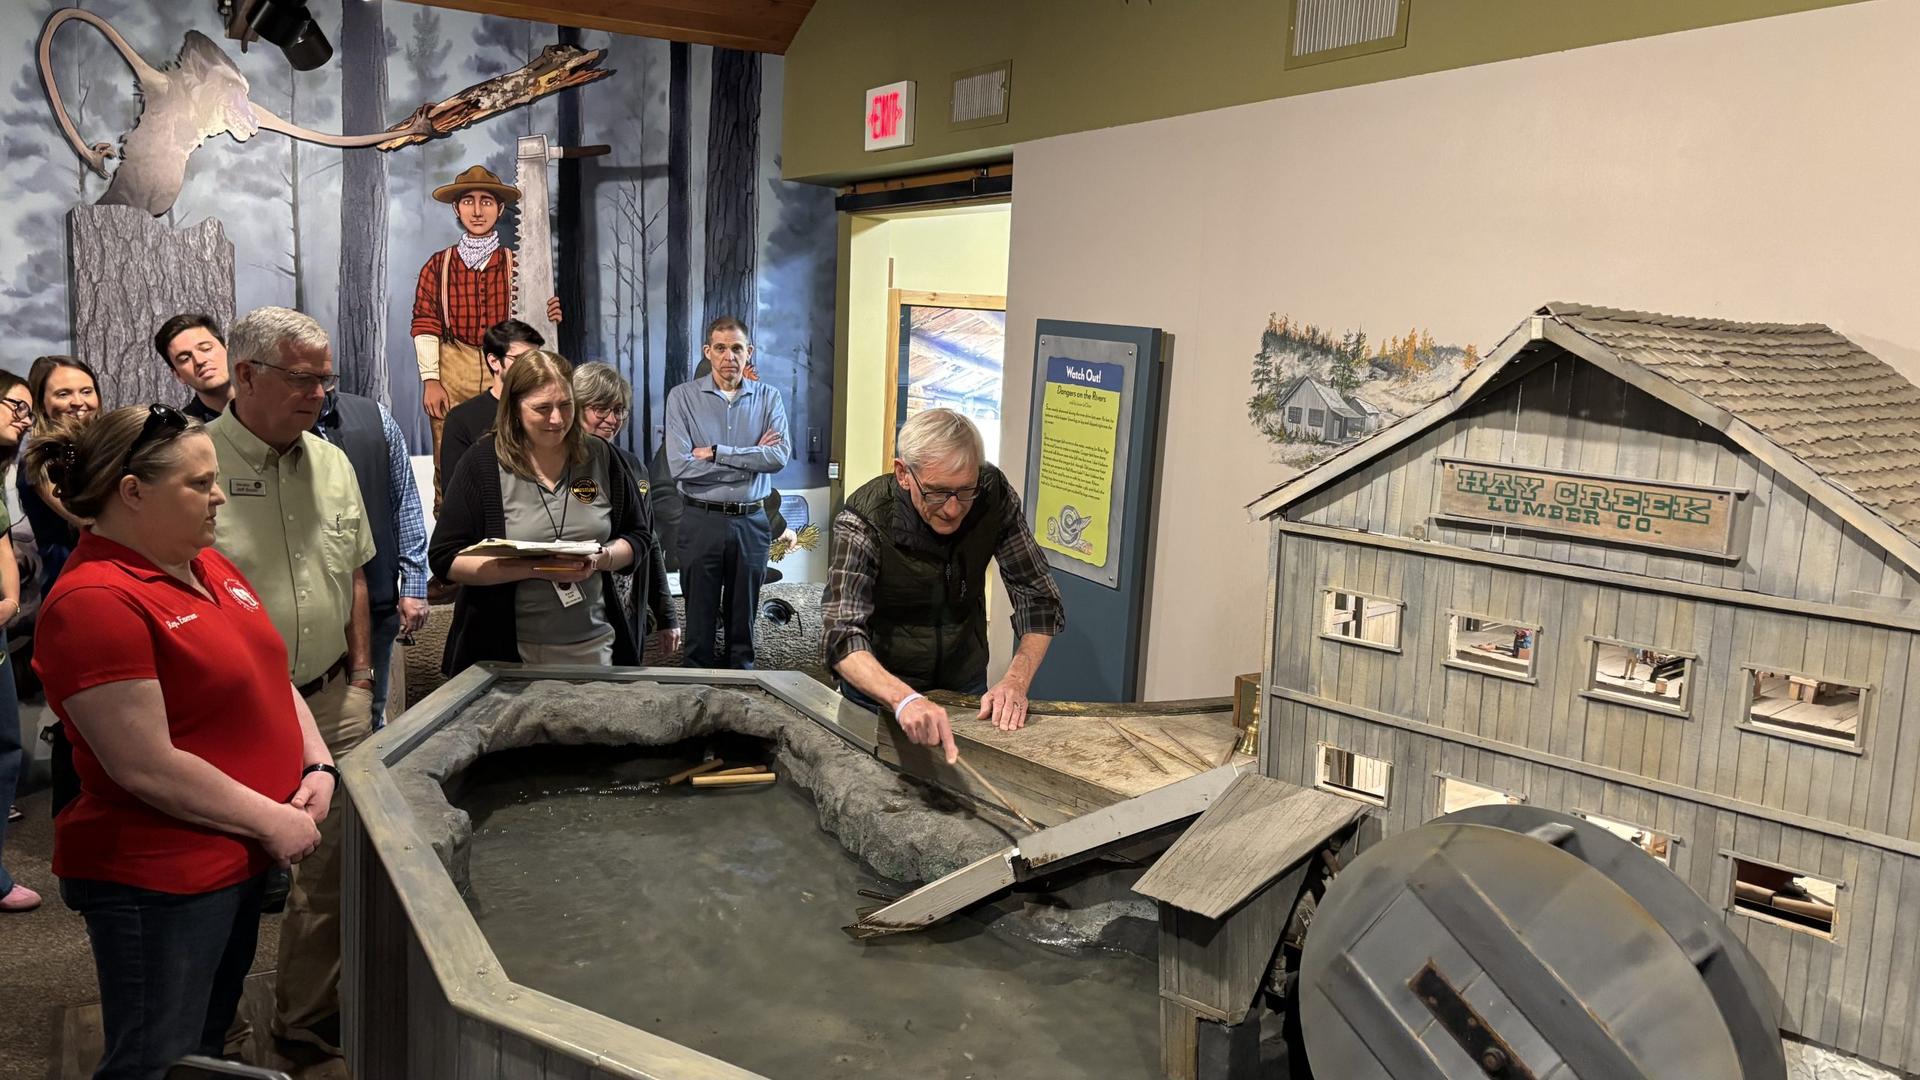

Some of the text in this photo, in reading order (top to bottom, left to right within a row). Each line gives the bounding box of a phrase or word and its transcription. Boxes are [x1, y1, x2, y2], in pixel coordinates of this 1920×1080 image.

[1066, 365, 1102, 383] Watch Out!
[1057, 385, 1077, 398] Dangers
[1083, 390, 1092, 400] the
[1092, 391, 1107, 403] Rivers
[1456, 468, 1713, 525] HAY CREEK
[1487, 495, 1662, 535] LUMBER CO.
